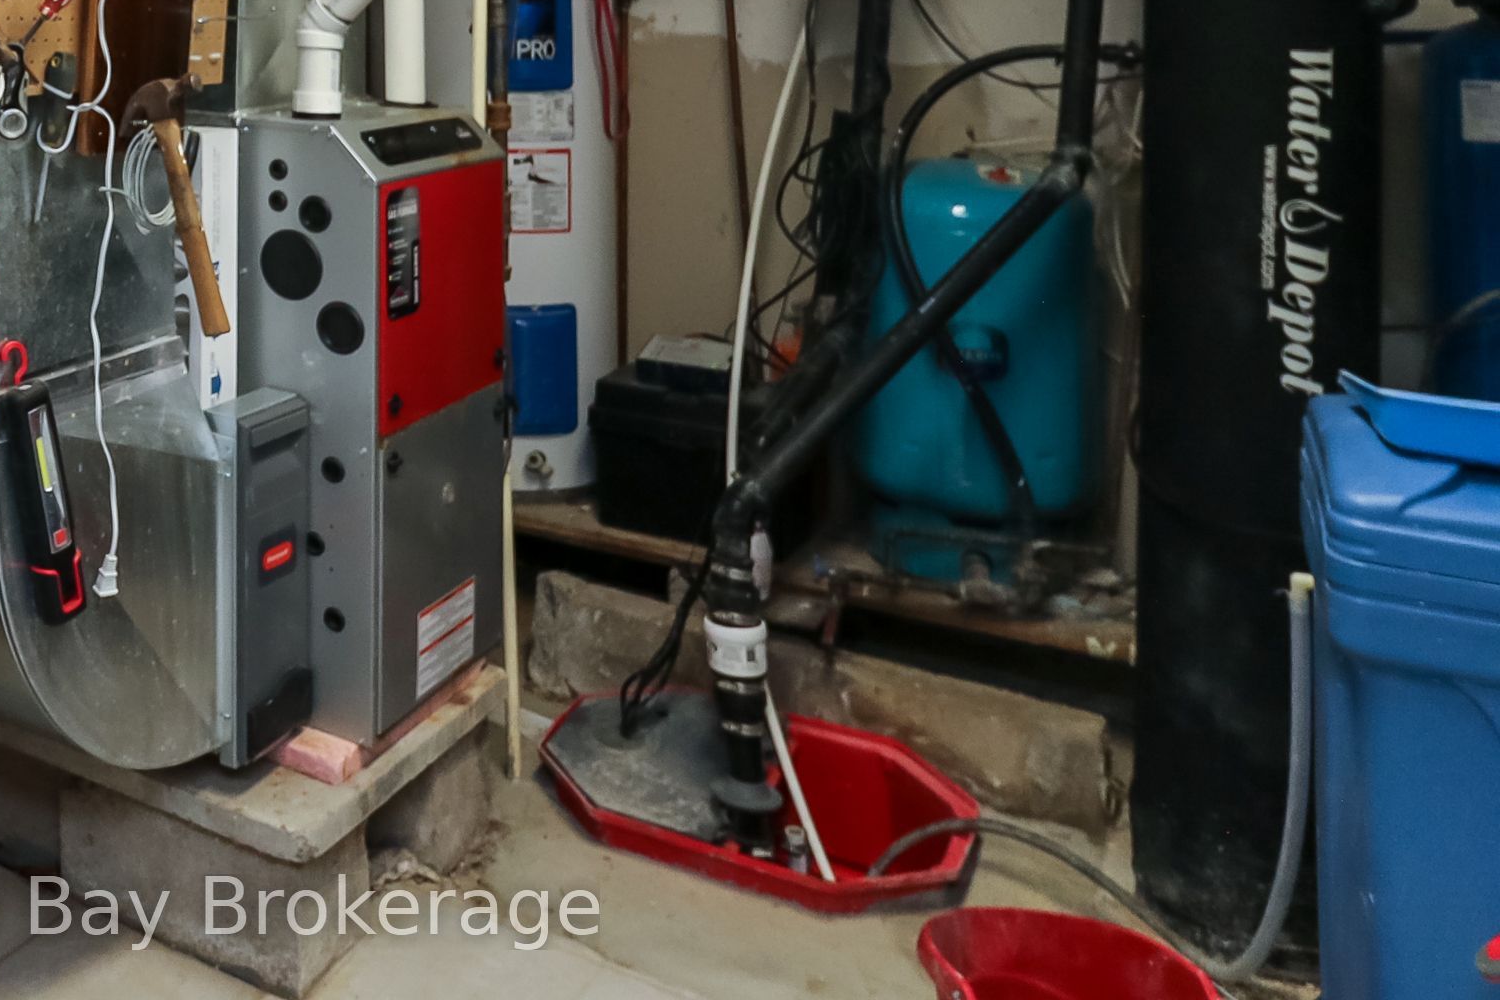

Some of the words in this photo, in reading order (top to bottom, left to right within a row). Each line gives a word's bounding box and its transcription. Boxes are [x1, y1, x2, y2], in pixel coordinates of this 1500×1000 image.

[516, 38, 556, 60] PRO
[1286, 48, 1334, 195] Water
[1267, 236, 1329, 393] Depot
